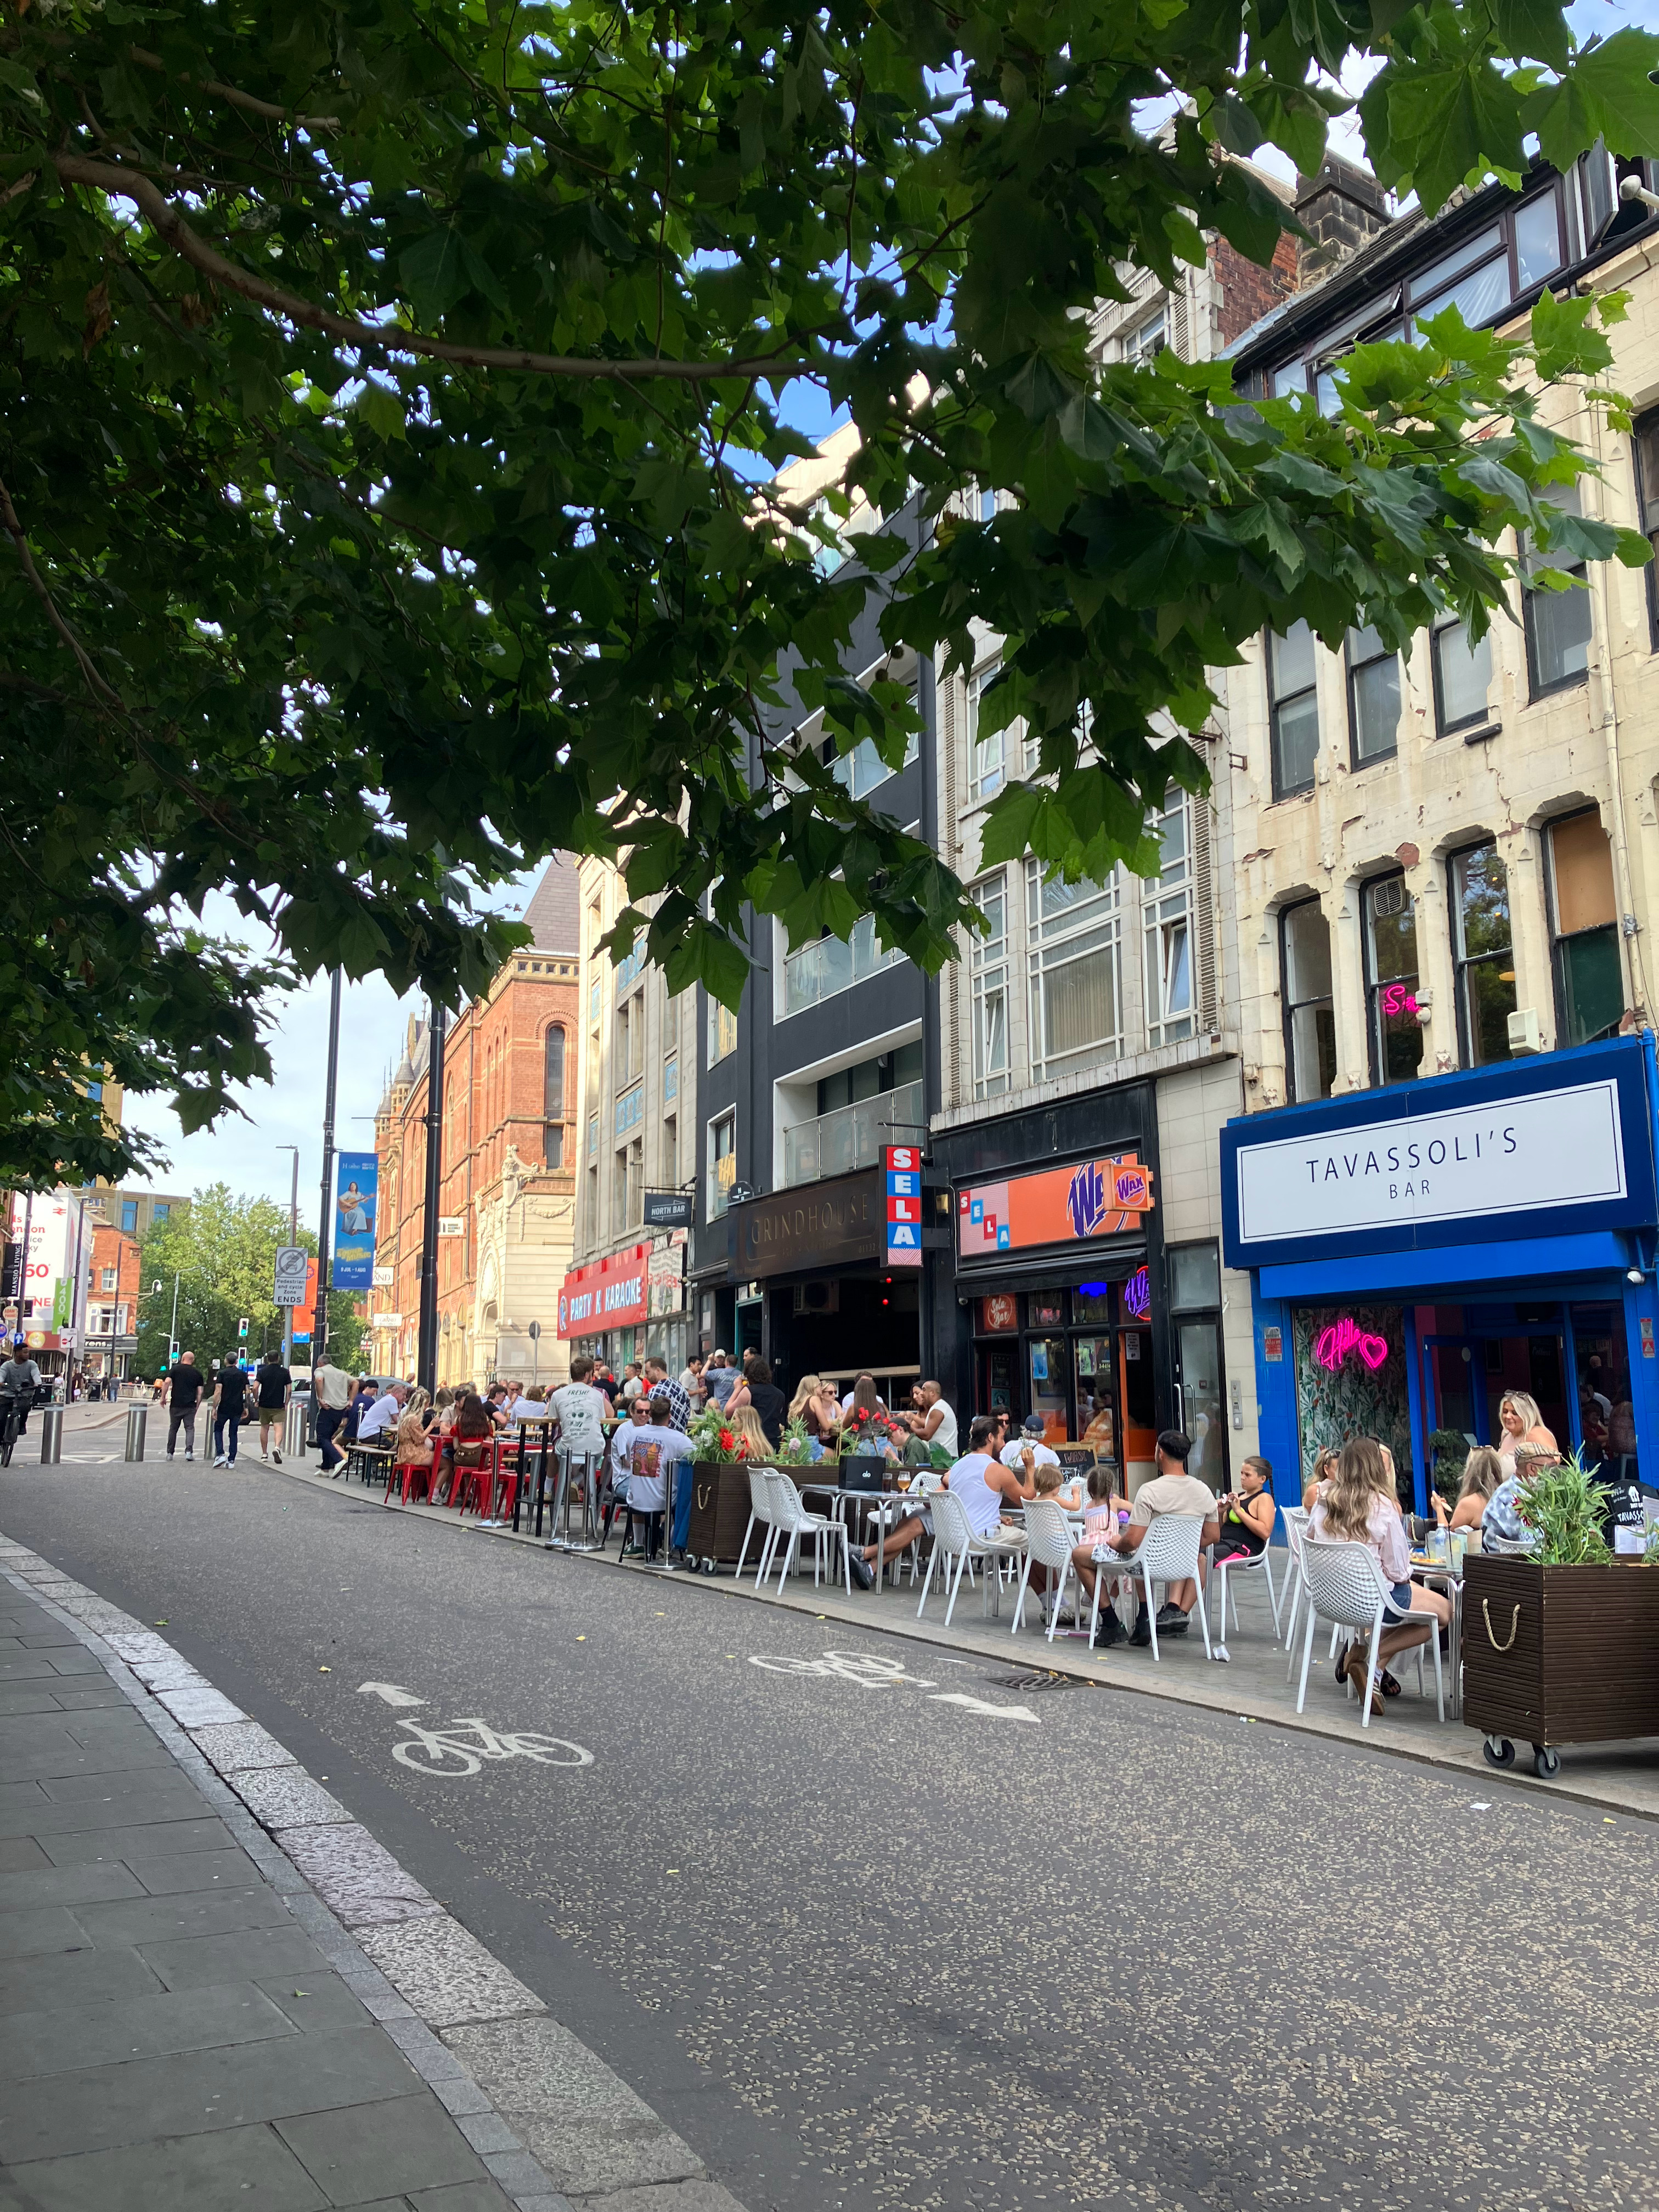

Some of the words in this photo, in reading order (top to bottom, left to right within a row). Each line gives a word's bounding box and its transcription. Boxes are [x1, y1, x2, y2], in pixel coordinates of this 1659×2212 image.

[1306, 1127, 1517, 1183] TAVASSOLI'S
[893, 1148, 916, 1245] SELA
[1115, 1175, 1144, 1202] WAX
[1389, 1180, 1430, 1199] BAR
[651, 1206, 671, 1216] NORTH
[673, 1205, 685, 1214] BAR
[751, 1193, 868, 1244] GRINDHOUSE
[13, 1245, 21, 1267] LIVING
[11, 1270, 19, 1295] MANSIO
[570, 1293, 592, 1322] PARTY
[596, 1289, 602, 1315] K
[605, 1276, 642, 1312] KARAOKE
[1064, 1451, 1087, 1464] WAX
